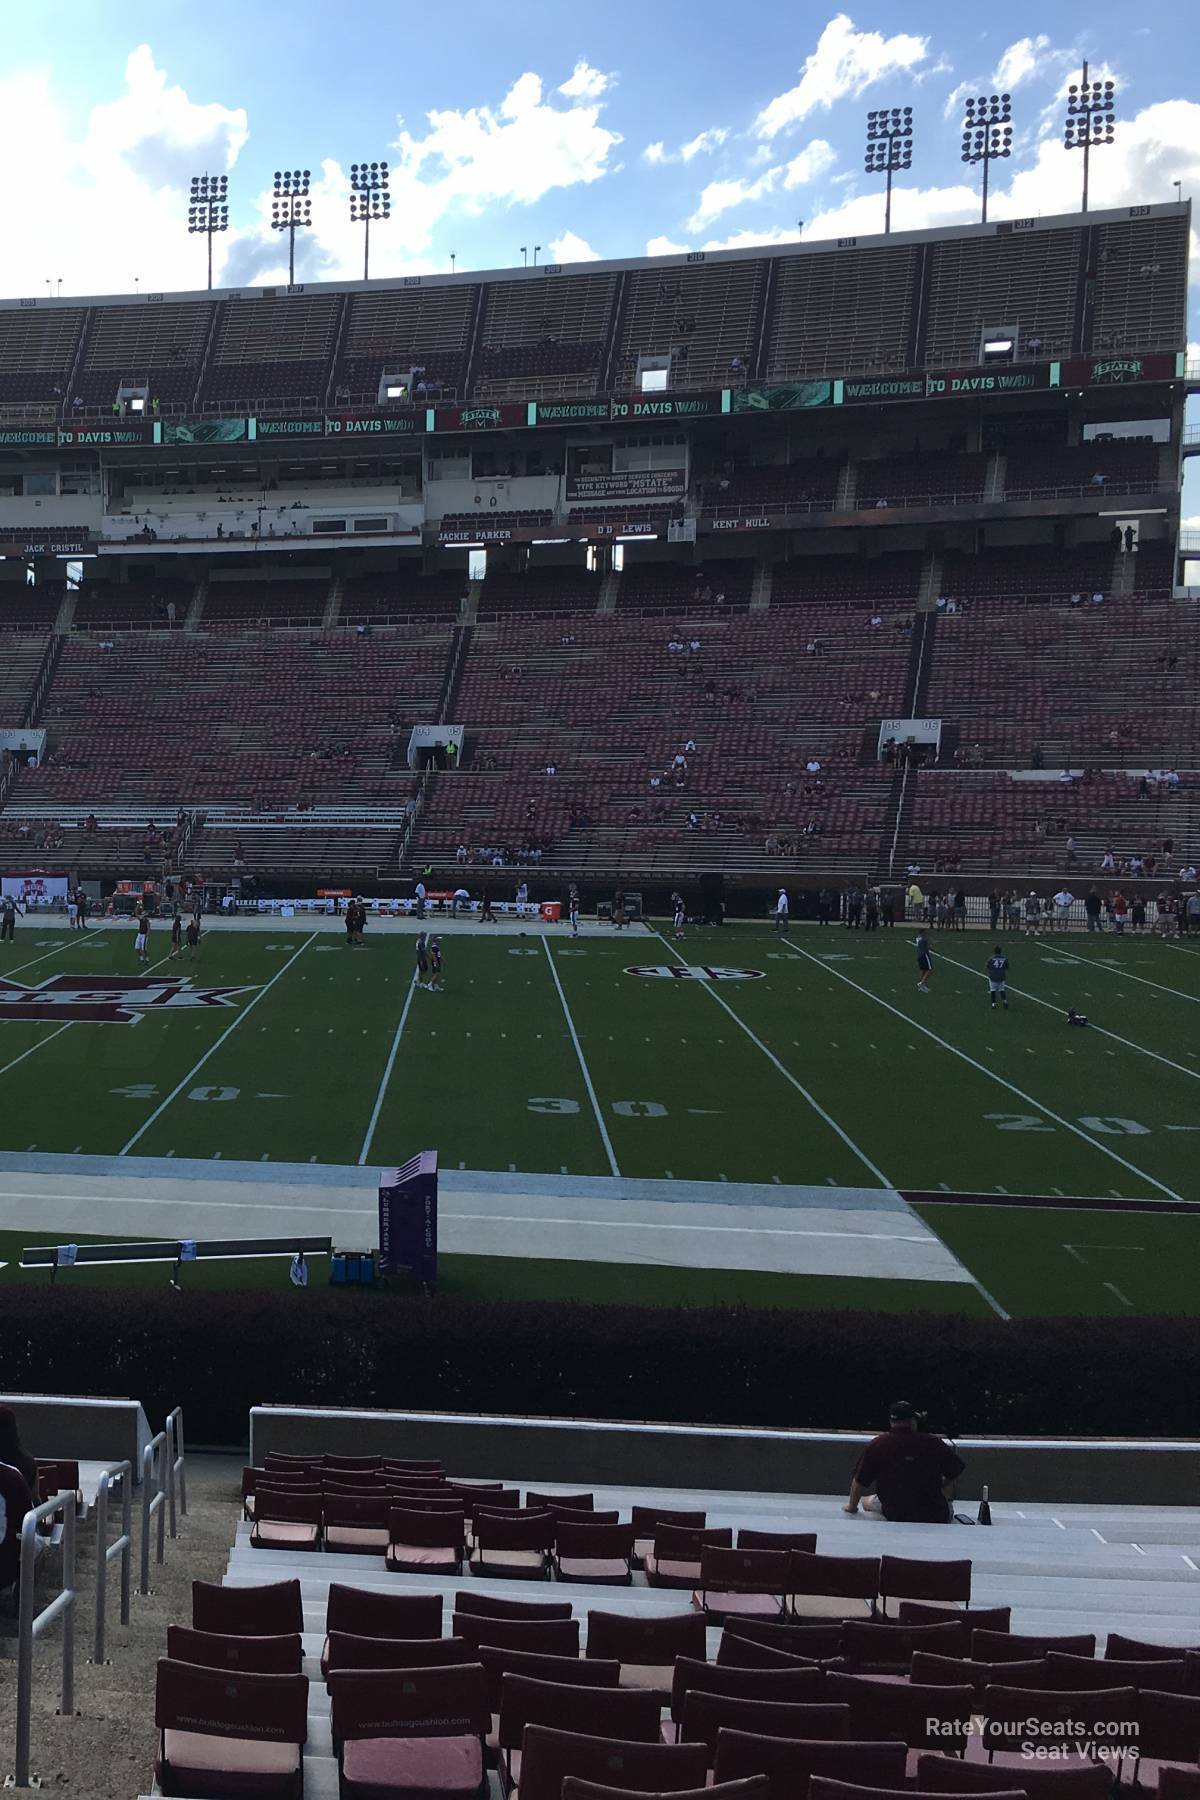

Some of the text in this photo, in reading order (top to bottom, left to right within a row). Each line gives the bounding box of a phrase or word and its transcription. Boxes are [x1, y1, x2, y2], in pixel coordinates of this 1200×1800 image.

[847, 382, 922, 396] WELCOME
[929, 379, 945, 392] TO
[951, 376, 995, 391] DAVIS
[539, 405, 607, 418] WELCOME
[613, 404, 628, 416] TO
[633, 402, 673, 415] DAVIS
[259, 421, 321, 433] WELCOME
[328, 421, 341, 432] TO
[345, 420, 381, 431] DAVIS
[60, 432, 73, 443] TO
[78, 432, 111, 443] DAVIS
[595, 481, 628, 489] KEYWORD
[626, 487, 657, 495] LOCATION
[622, 524, 652, 534] LEWIS
[712, 518, 770, 529] KENT HULL
[437, 530, 512, 542] JACKIE PARKER
[24, 543, 83, 553] JACK CRISTIL
[448, 726, 460, 735] 05
[544, 907, 553, 915] G
[992, 957, 1005, 969] 47
[108, 1083, 241, 1100] 40
[527, 1097, 668, 1117] 30
[982, 1113, 1153, 1135] 20
